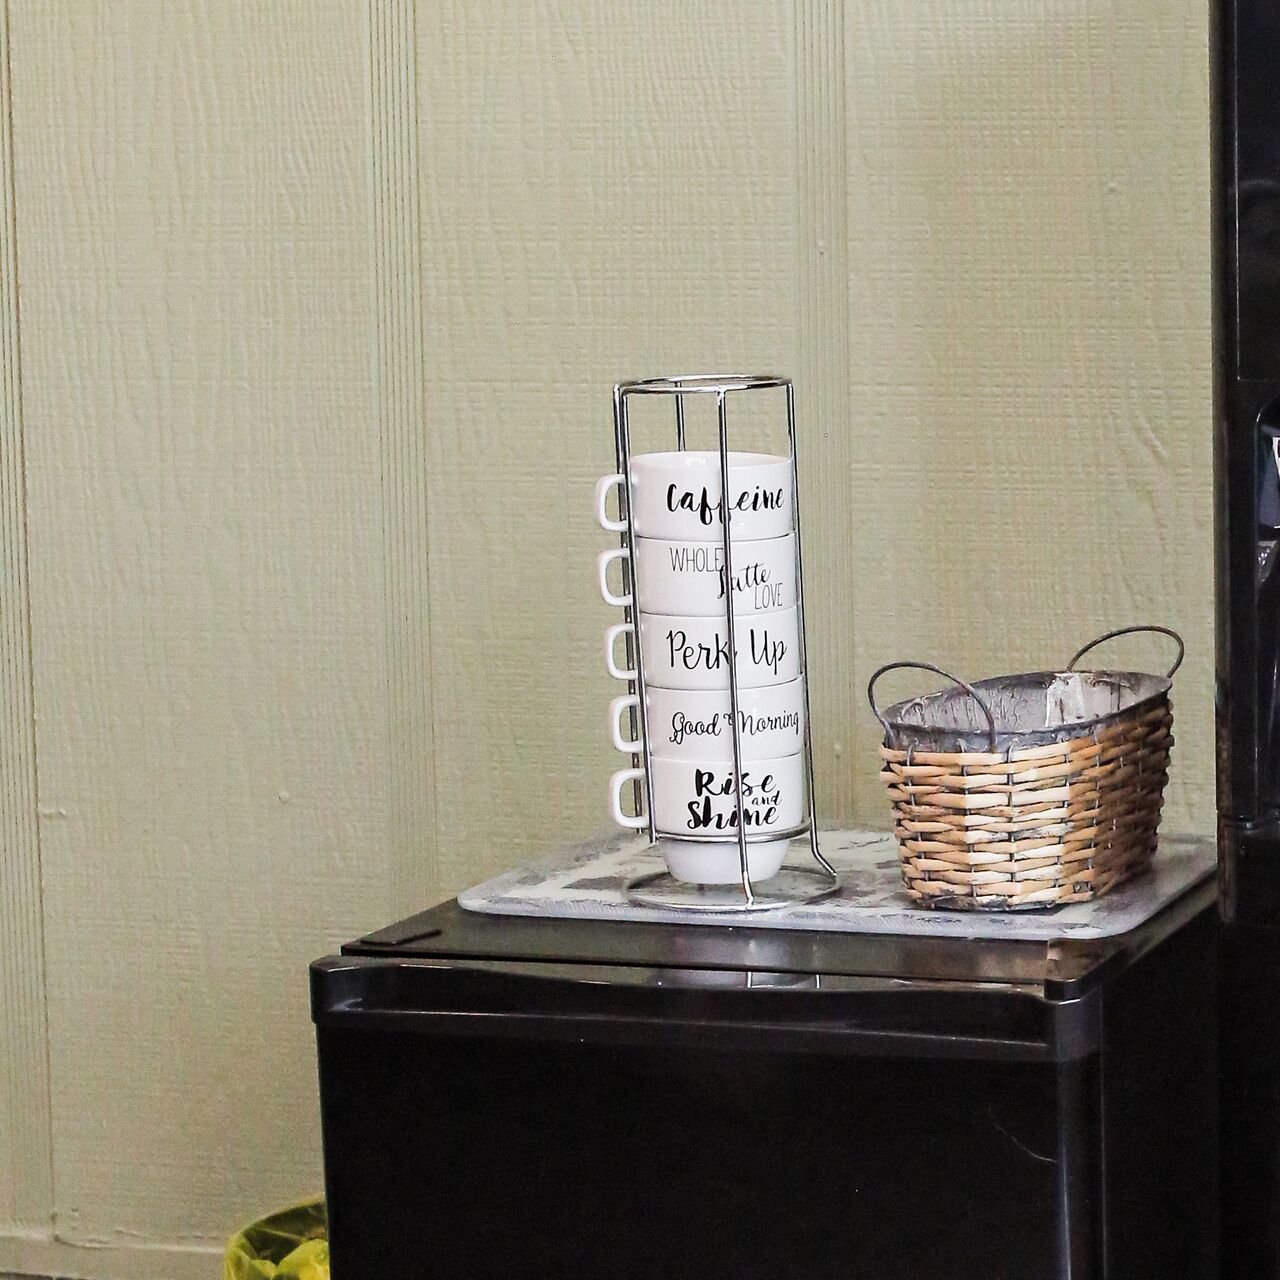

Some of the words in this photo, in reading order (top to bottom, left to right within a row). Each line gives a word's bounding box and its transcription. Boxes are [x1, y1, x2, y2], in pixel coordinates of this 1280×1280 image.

[669, 547, 724, 573] WHOLE
[754, 582, 784, 610] LOVE
[666, 629, 737, 670] Perk
[750, 628, 788, 675] Up
[669, 711, 722, 745] Good
[723, 710, 799, 736] Morning
[694, 768, 778, 797] Rise
[686, 795, 780, 831] Shine
[751, 790, 783, 807] and
